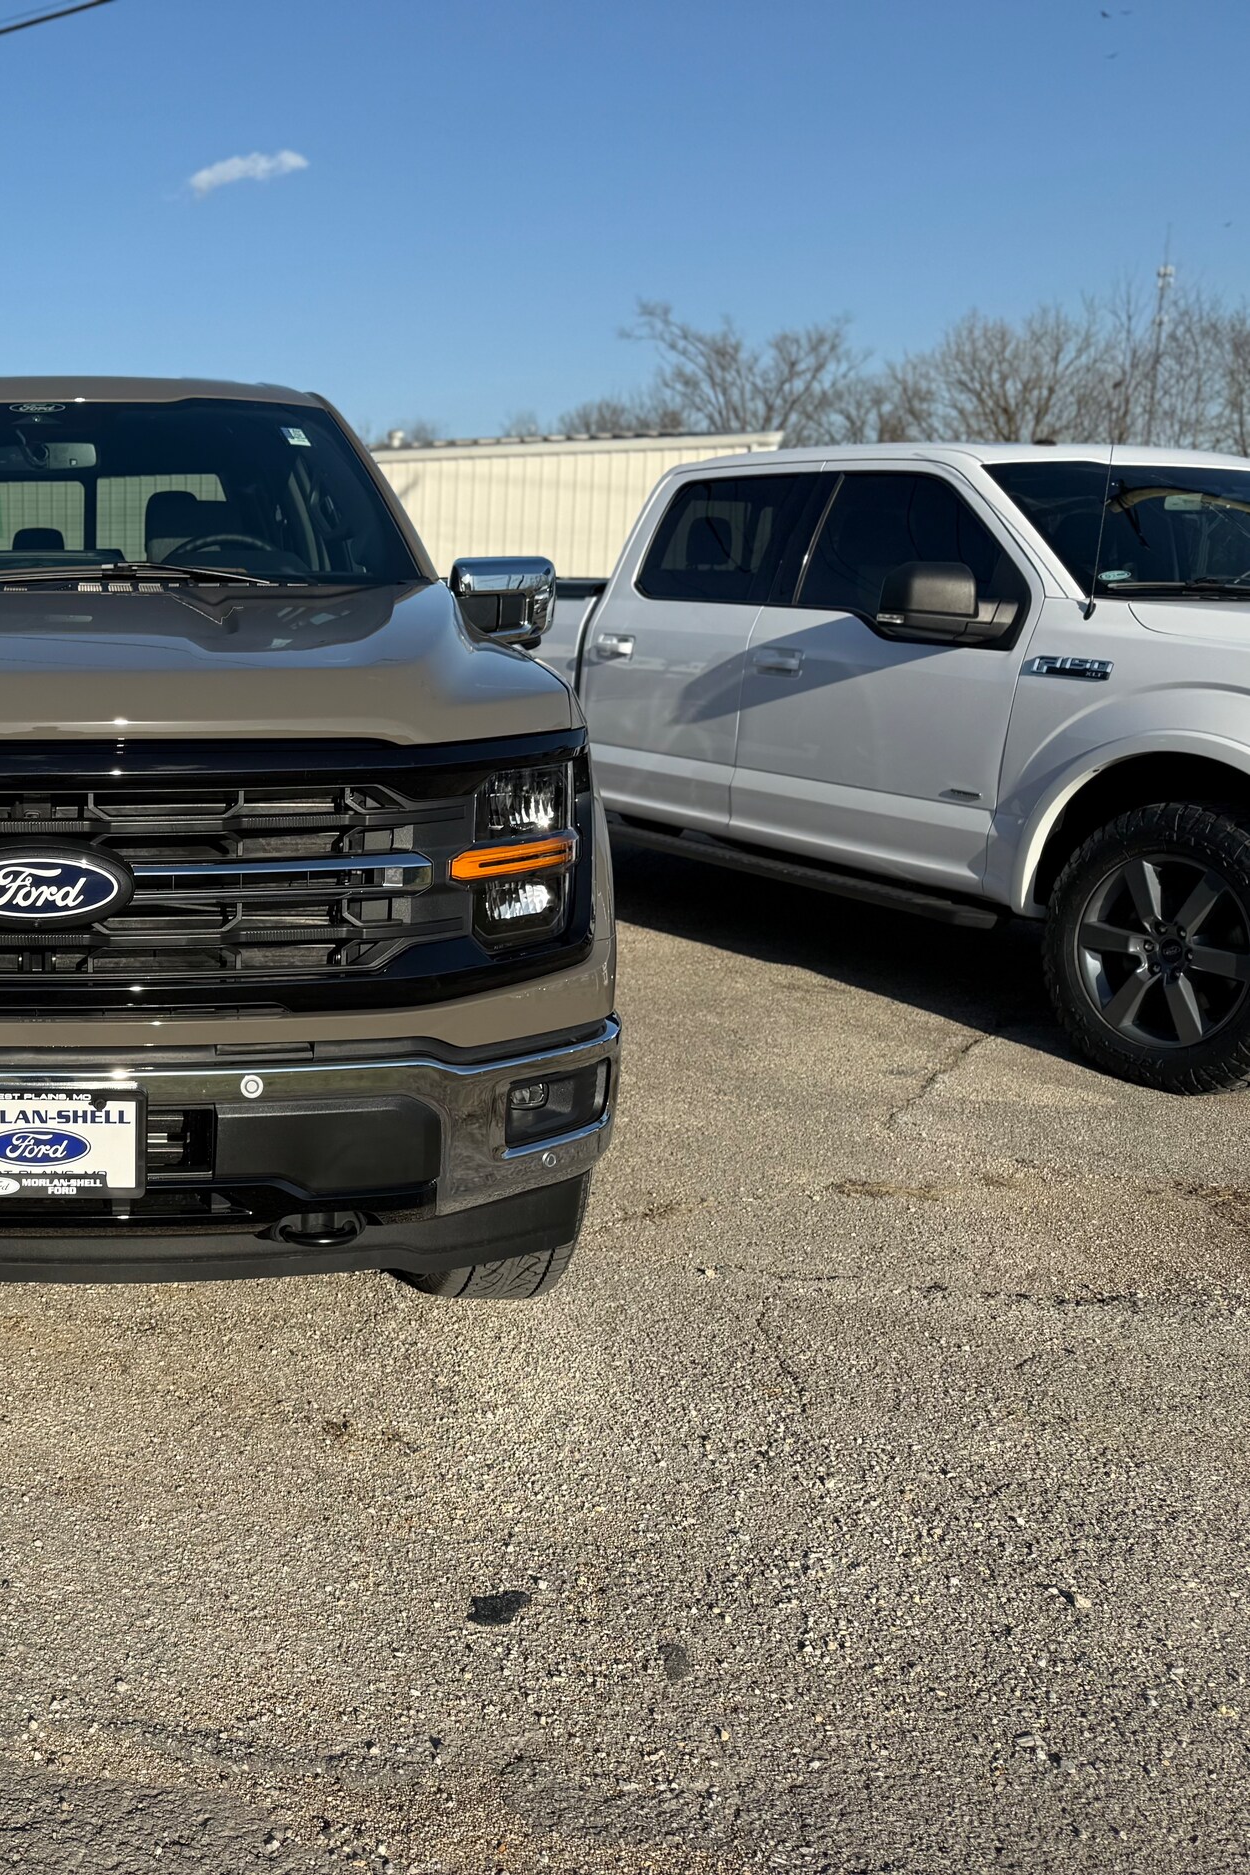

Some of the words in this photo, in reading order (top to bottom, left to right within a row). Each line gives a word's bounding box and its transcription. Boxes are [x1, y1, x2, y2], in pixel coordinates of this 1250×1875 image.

[23, 1093, 69, 1101] PLAINS,
[72, 1093, 91, 1101] MO
[6, 1133, 68, 1158] Ford
[22, 1179, 103, 1187] MORLAN-SHELL
[48, 1186, 77, 1194] FORD
